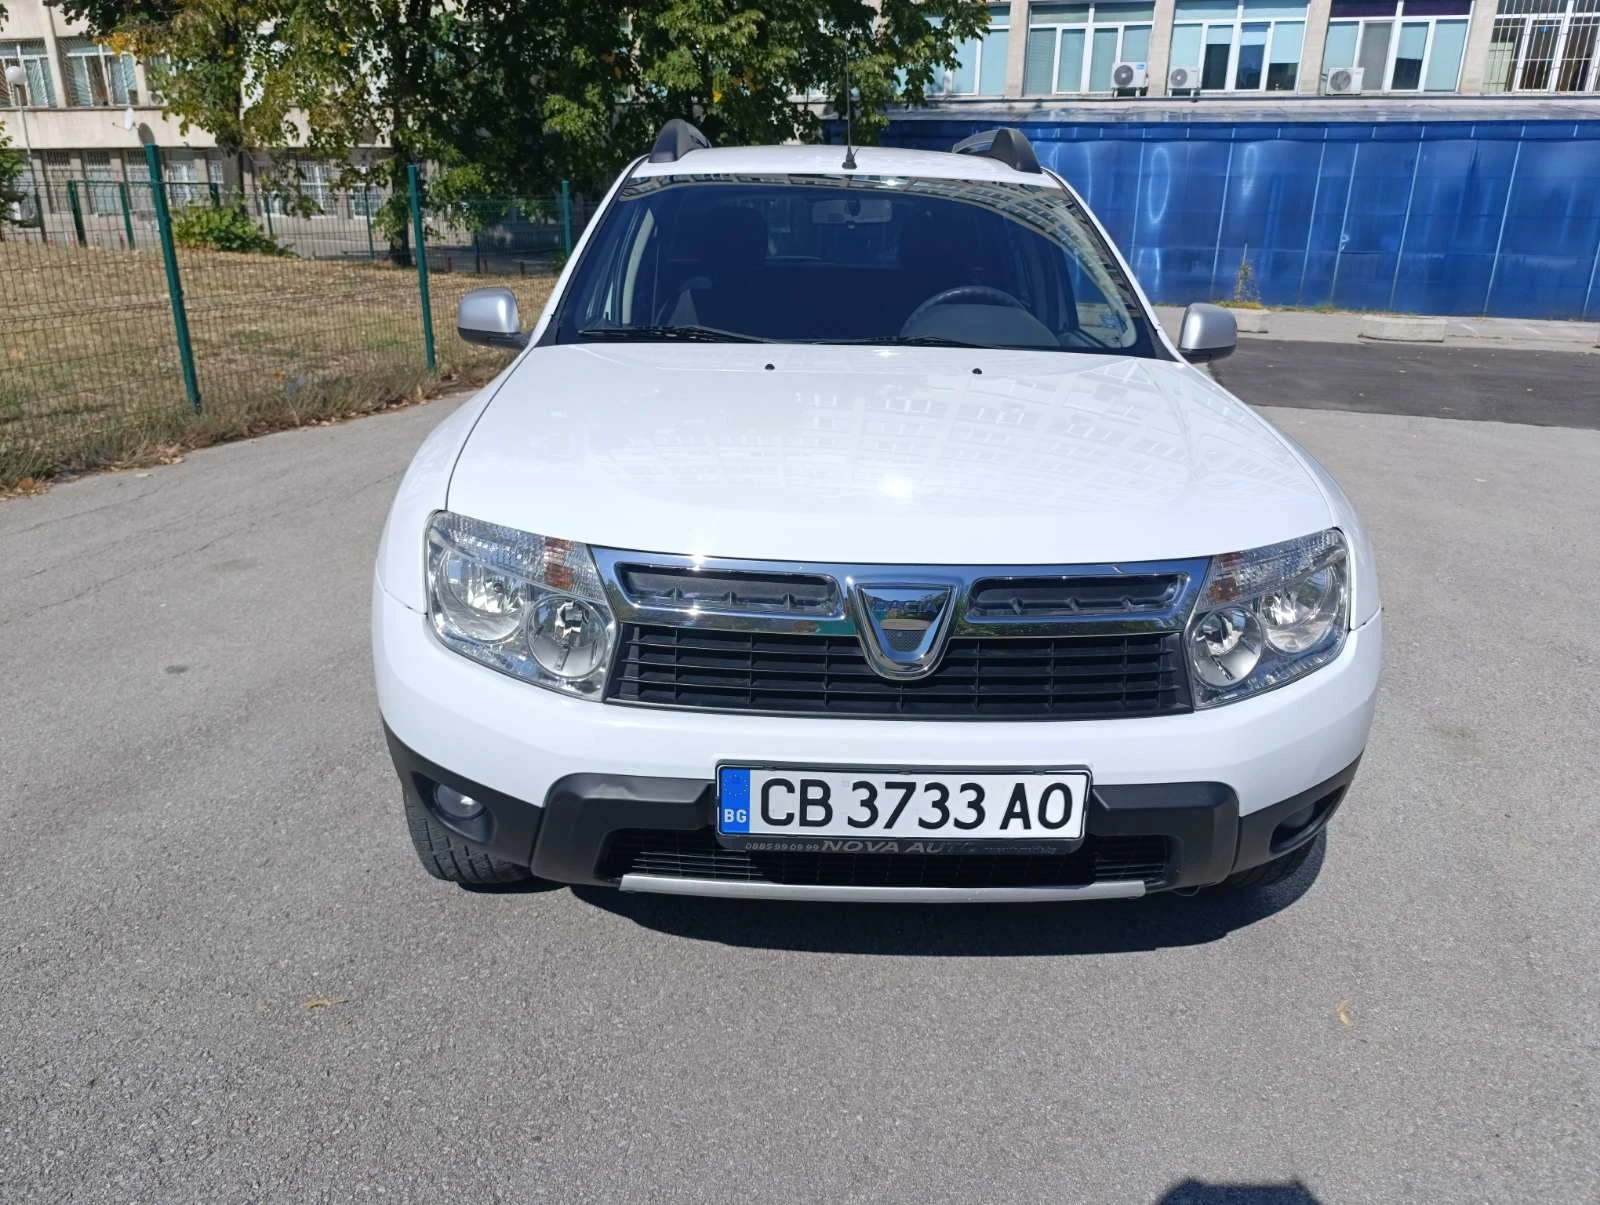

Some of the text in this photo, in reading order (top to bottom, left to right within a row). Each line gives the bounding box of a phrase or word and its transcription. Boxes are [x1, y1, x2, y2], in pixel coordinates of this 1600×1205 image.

[761, 778, 1073, 830] CB 3733 AO
[724, 808, 747, 823] BG
[821, 840, 899, 853] NOVA
